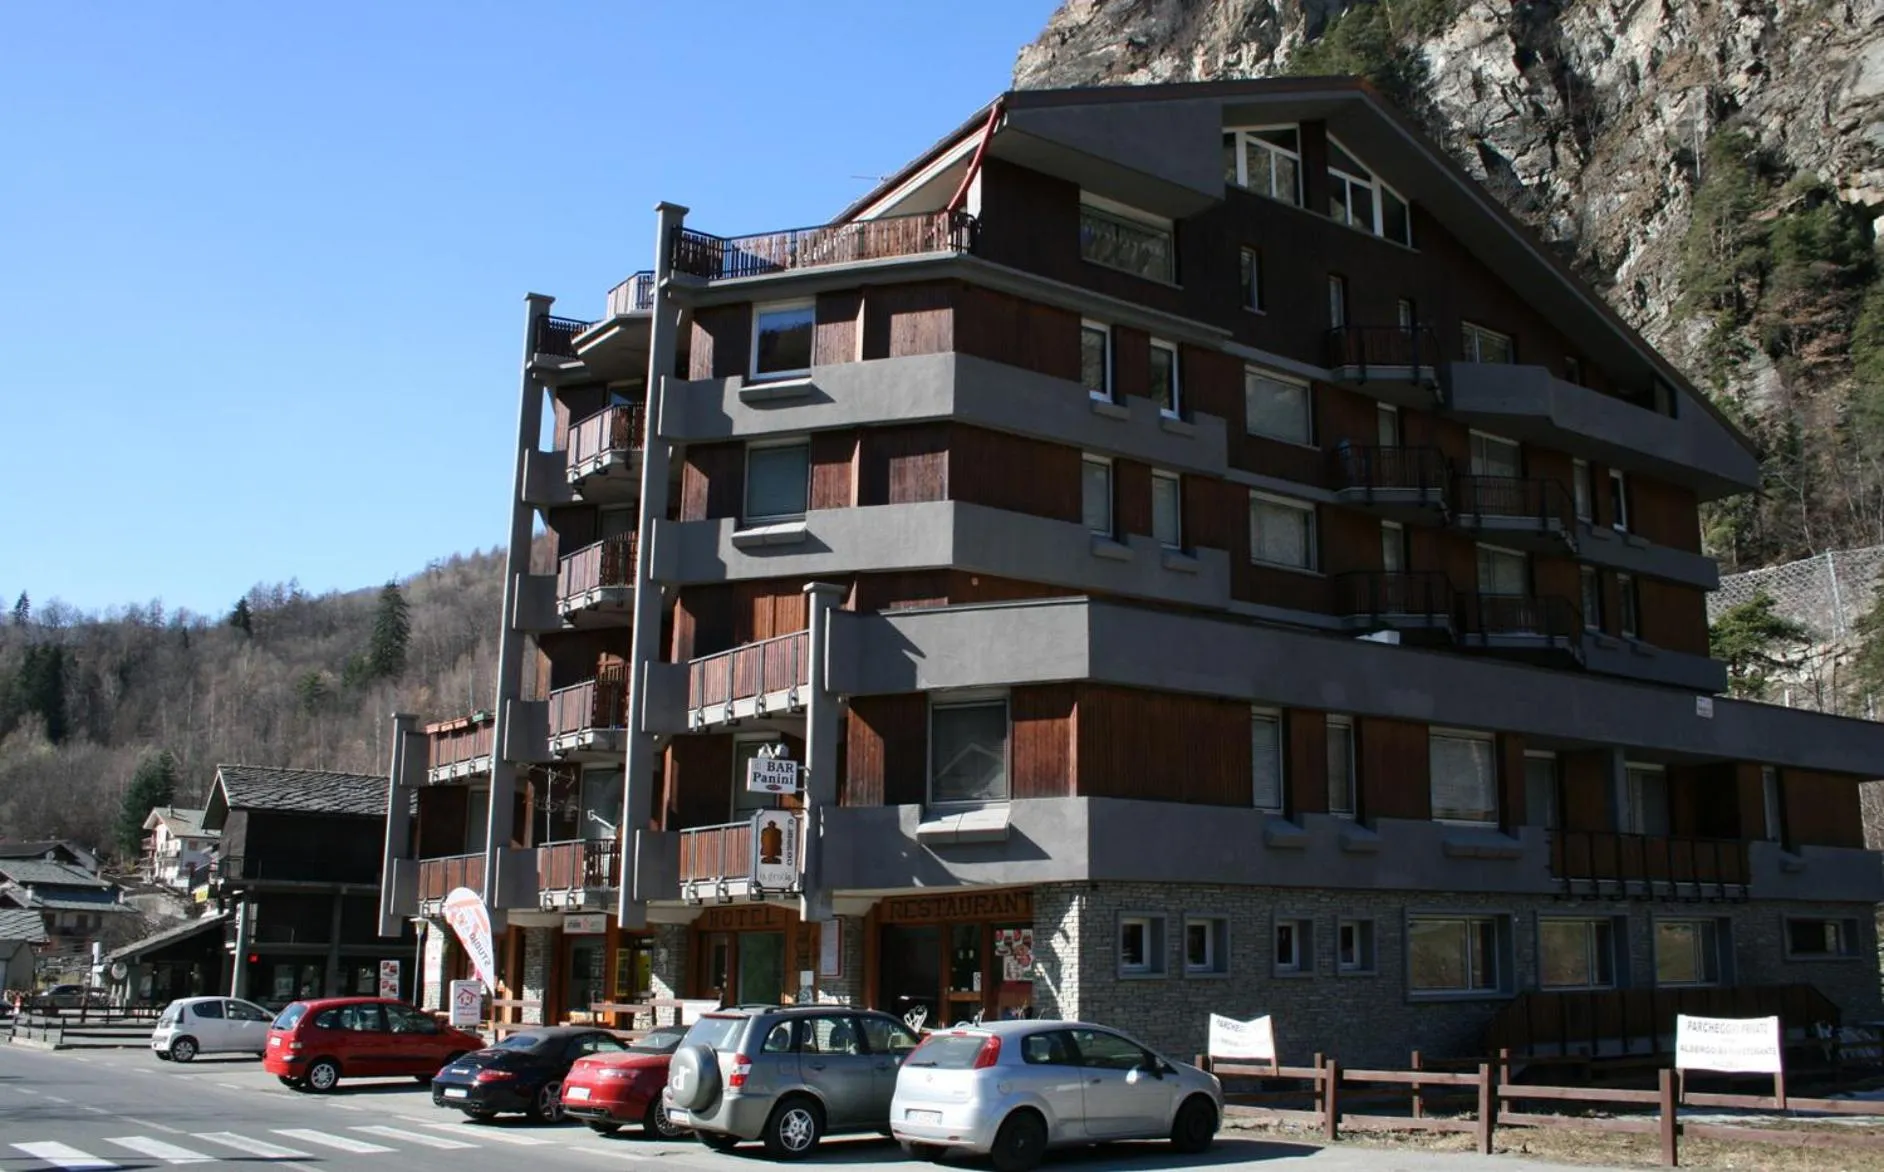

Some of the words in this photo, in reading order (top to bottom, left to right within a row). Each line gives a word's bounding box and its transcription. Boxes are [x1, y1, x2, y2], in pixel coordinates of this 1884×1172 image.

[767, 761, 794, 773] BAR
[753, 771, 793, 785] Panini
[889, 891, 1033, 919] RESTAURANT
[709, 907, 776, 927] HOTEL
